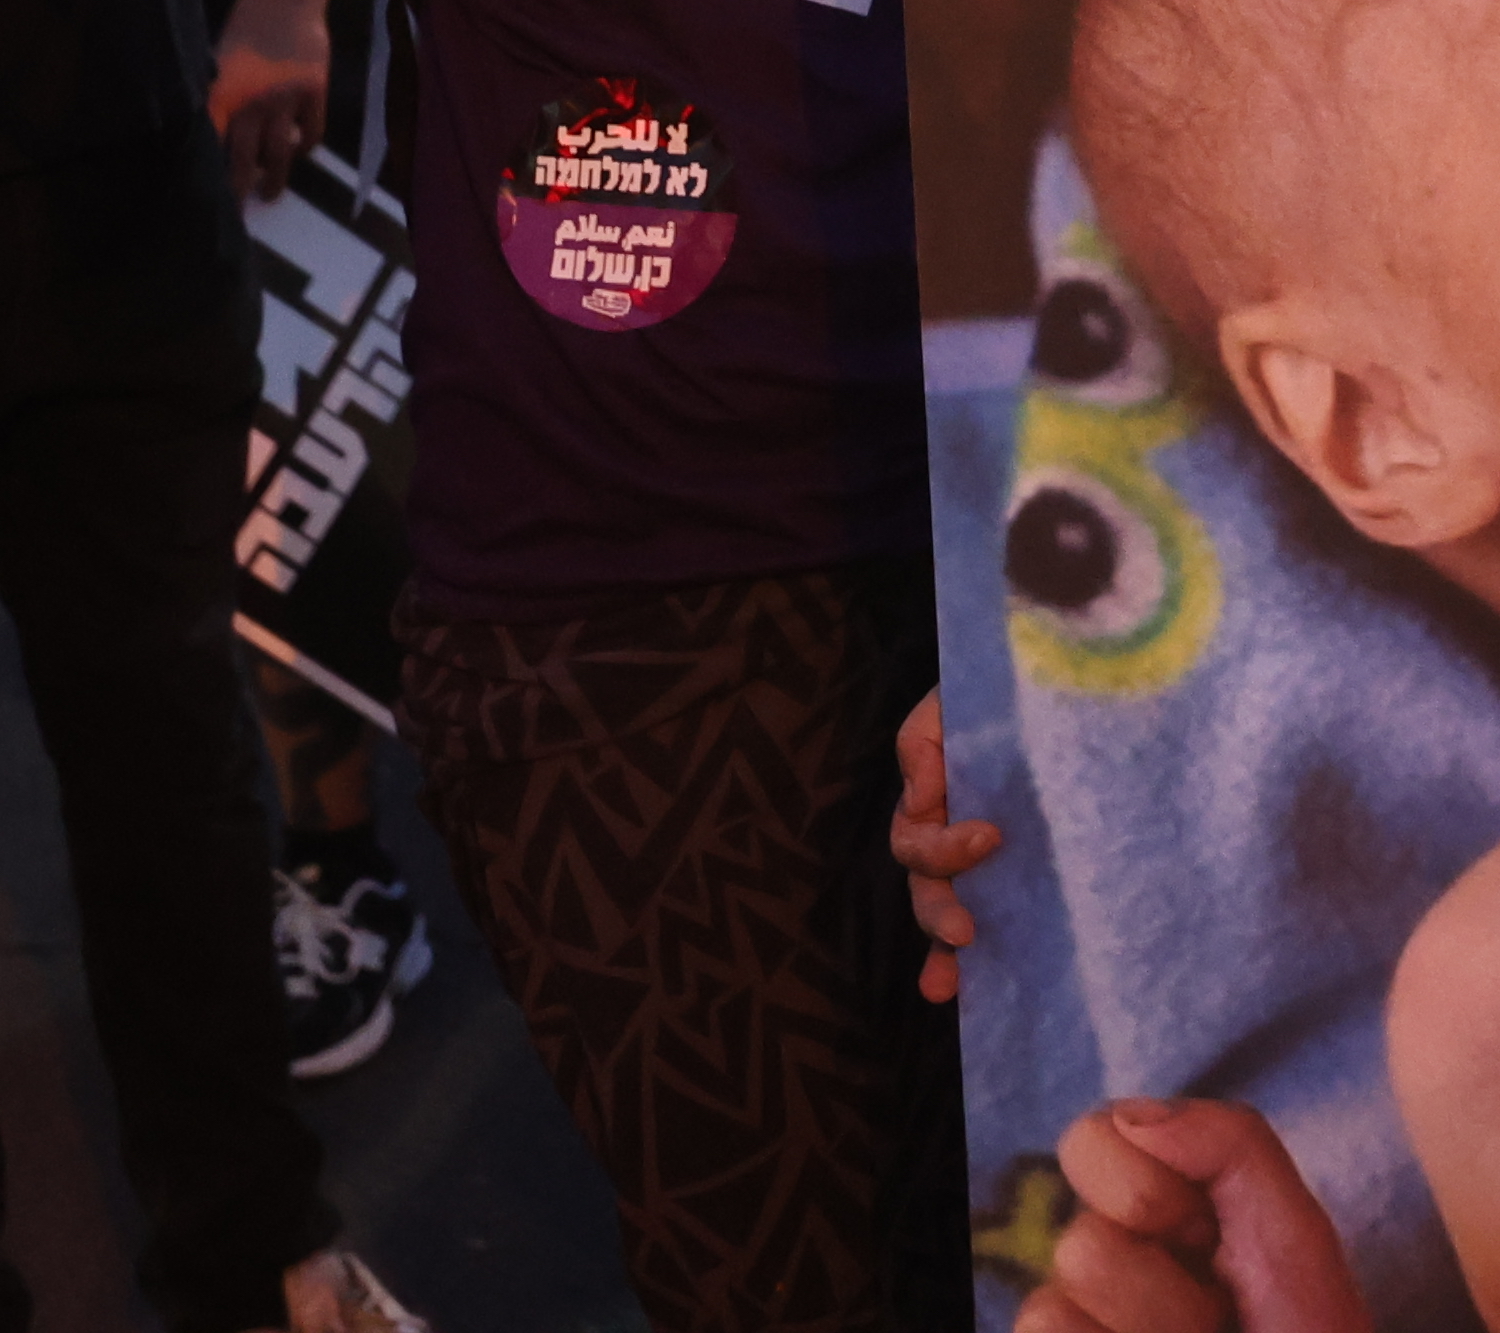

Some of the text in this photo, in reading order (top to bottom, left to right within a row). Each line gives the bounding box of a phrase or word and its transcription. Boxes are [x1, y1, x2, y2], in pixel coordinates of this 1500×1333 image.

[557, 119, 689, 155] لا للحرب
[534, 155, 709, 198] לא למלחמה
[555, 213, 622, 246] سلام
[550, 246, 635, 286] שלום
